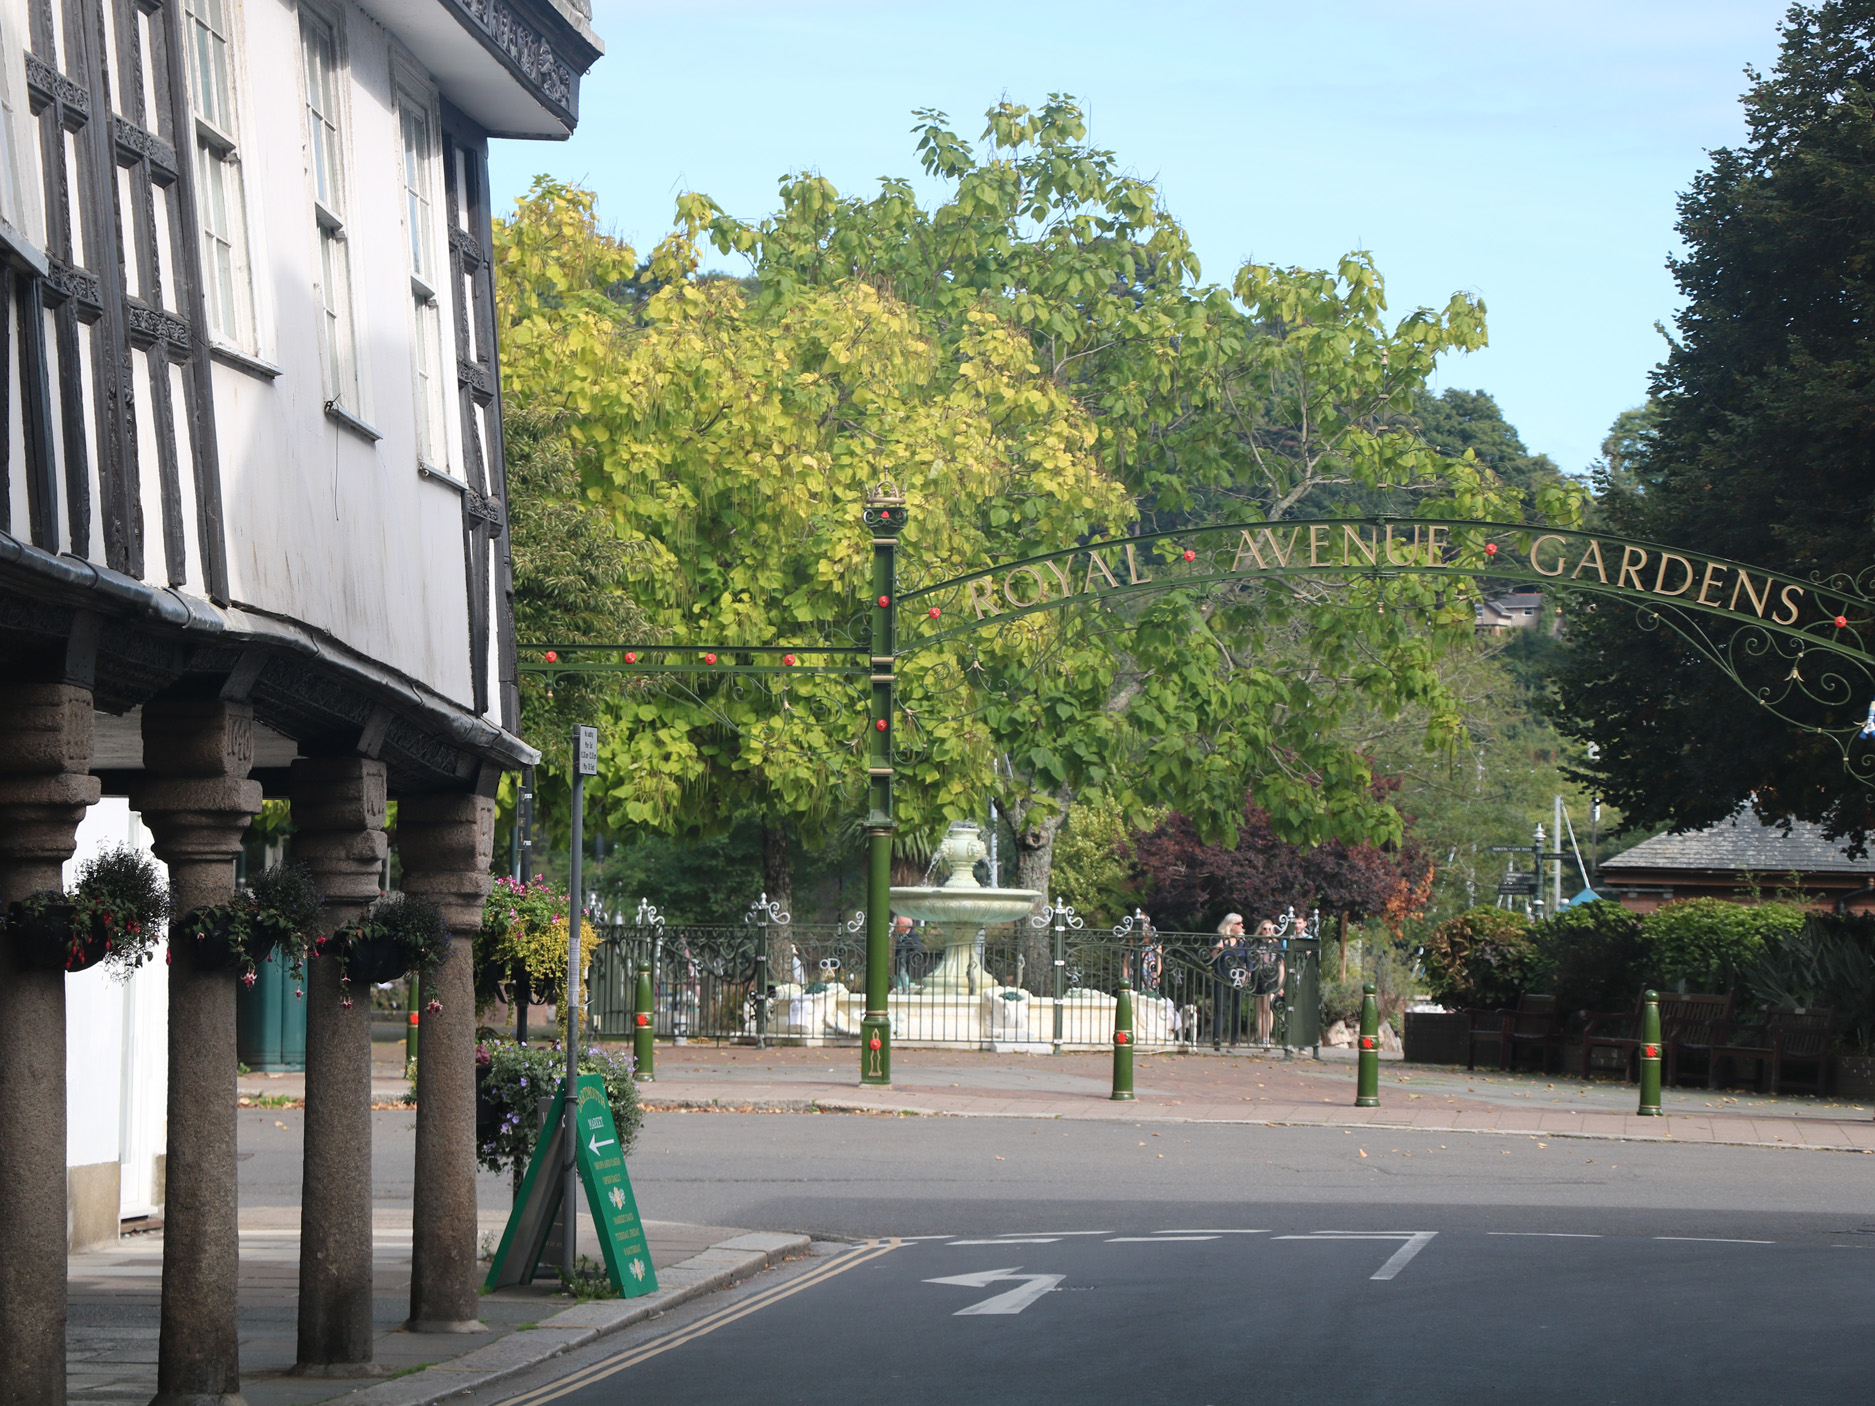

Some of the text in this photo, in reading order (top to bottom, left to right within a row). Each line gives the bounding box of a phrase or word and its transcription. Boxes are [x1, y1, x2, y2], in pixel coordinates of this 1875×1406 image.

[967, 524, 1805, 626] ROYAL AVENUE GARDENS
